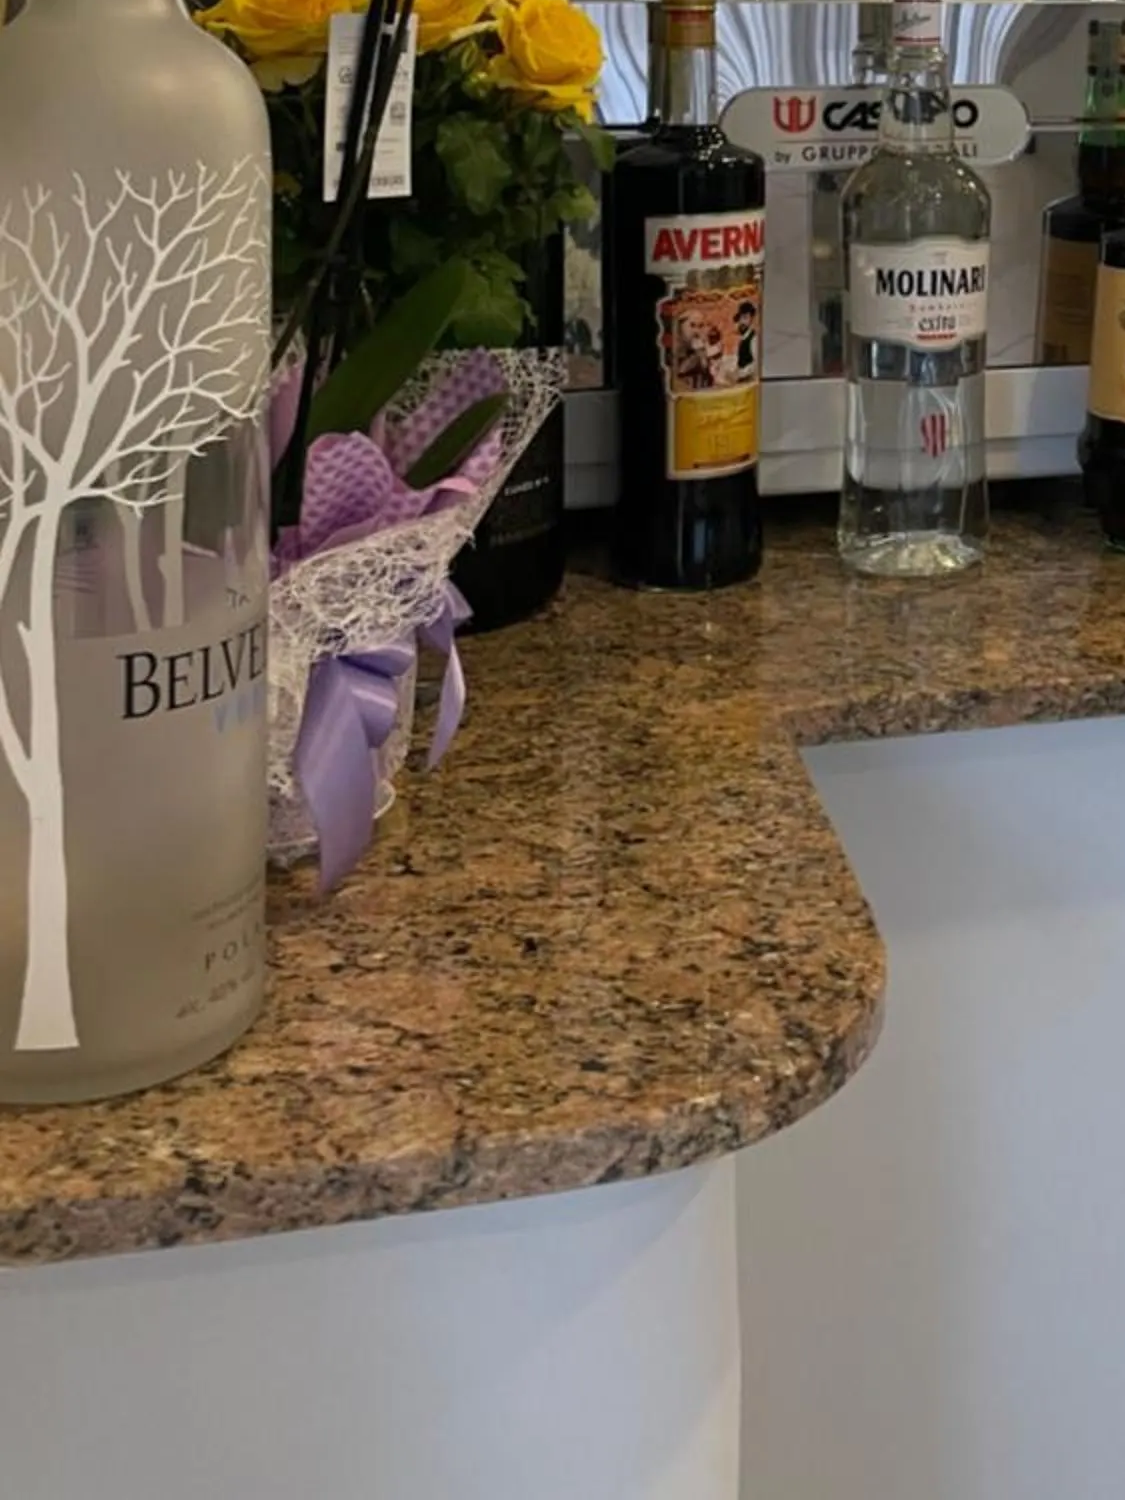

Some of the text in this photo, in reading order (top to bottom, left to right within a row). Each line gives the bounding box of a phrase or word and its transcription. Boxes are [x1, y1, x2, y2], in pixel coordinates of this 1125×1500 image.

[823, 99, 979, 132] CASO
[876, 265, 985, 297] MOLINARI
[115, 619, 268, 721] BELVE
